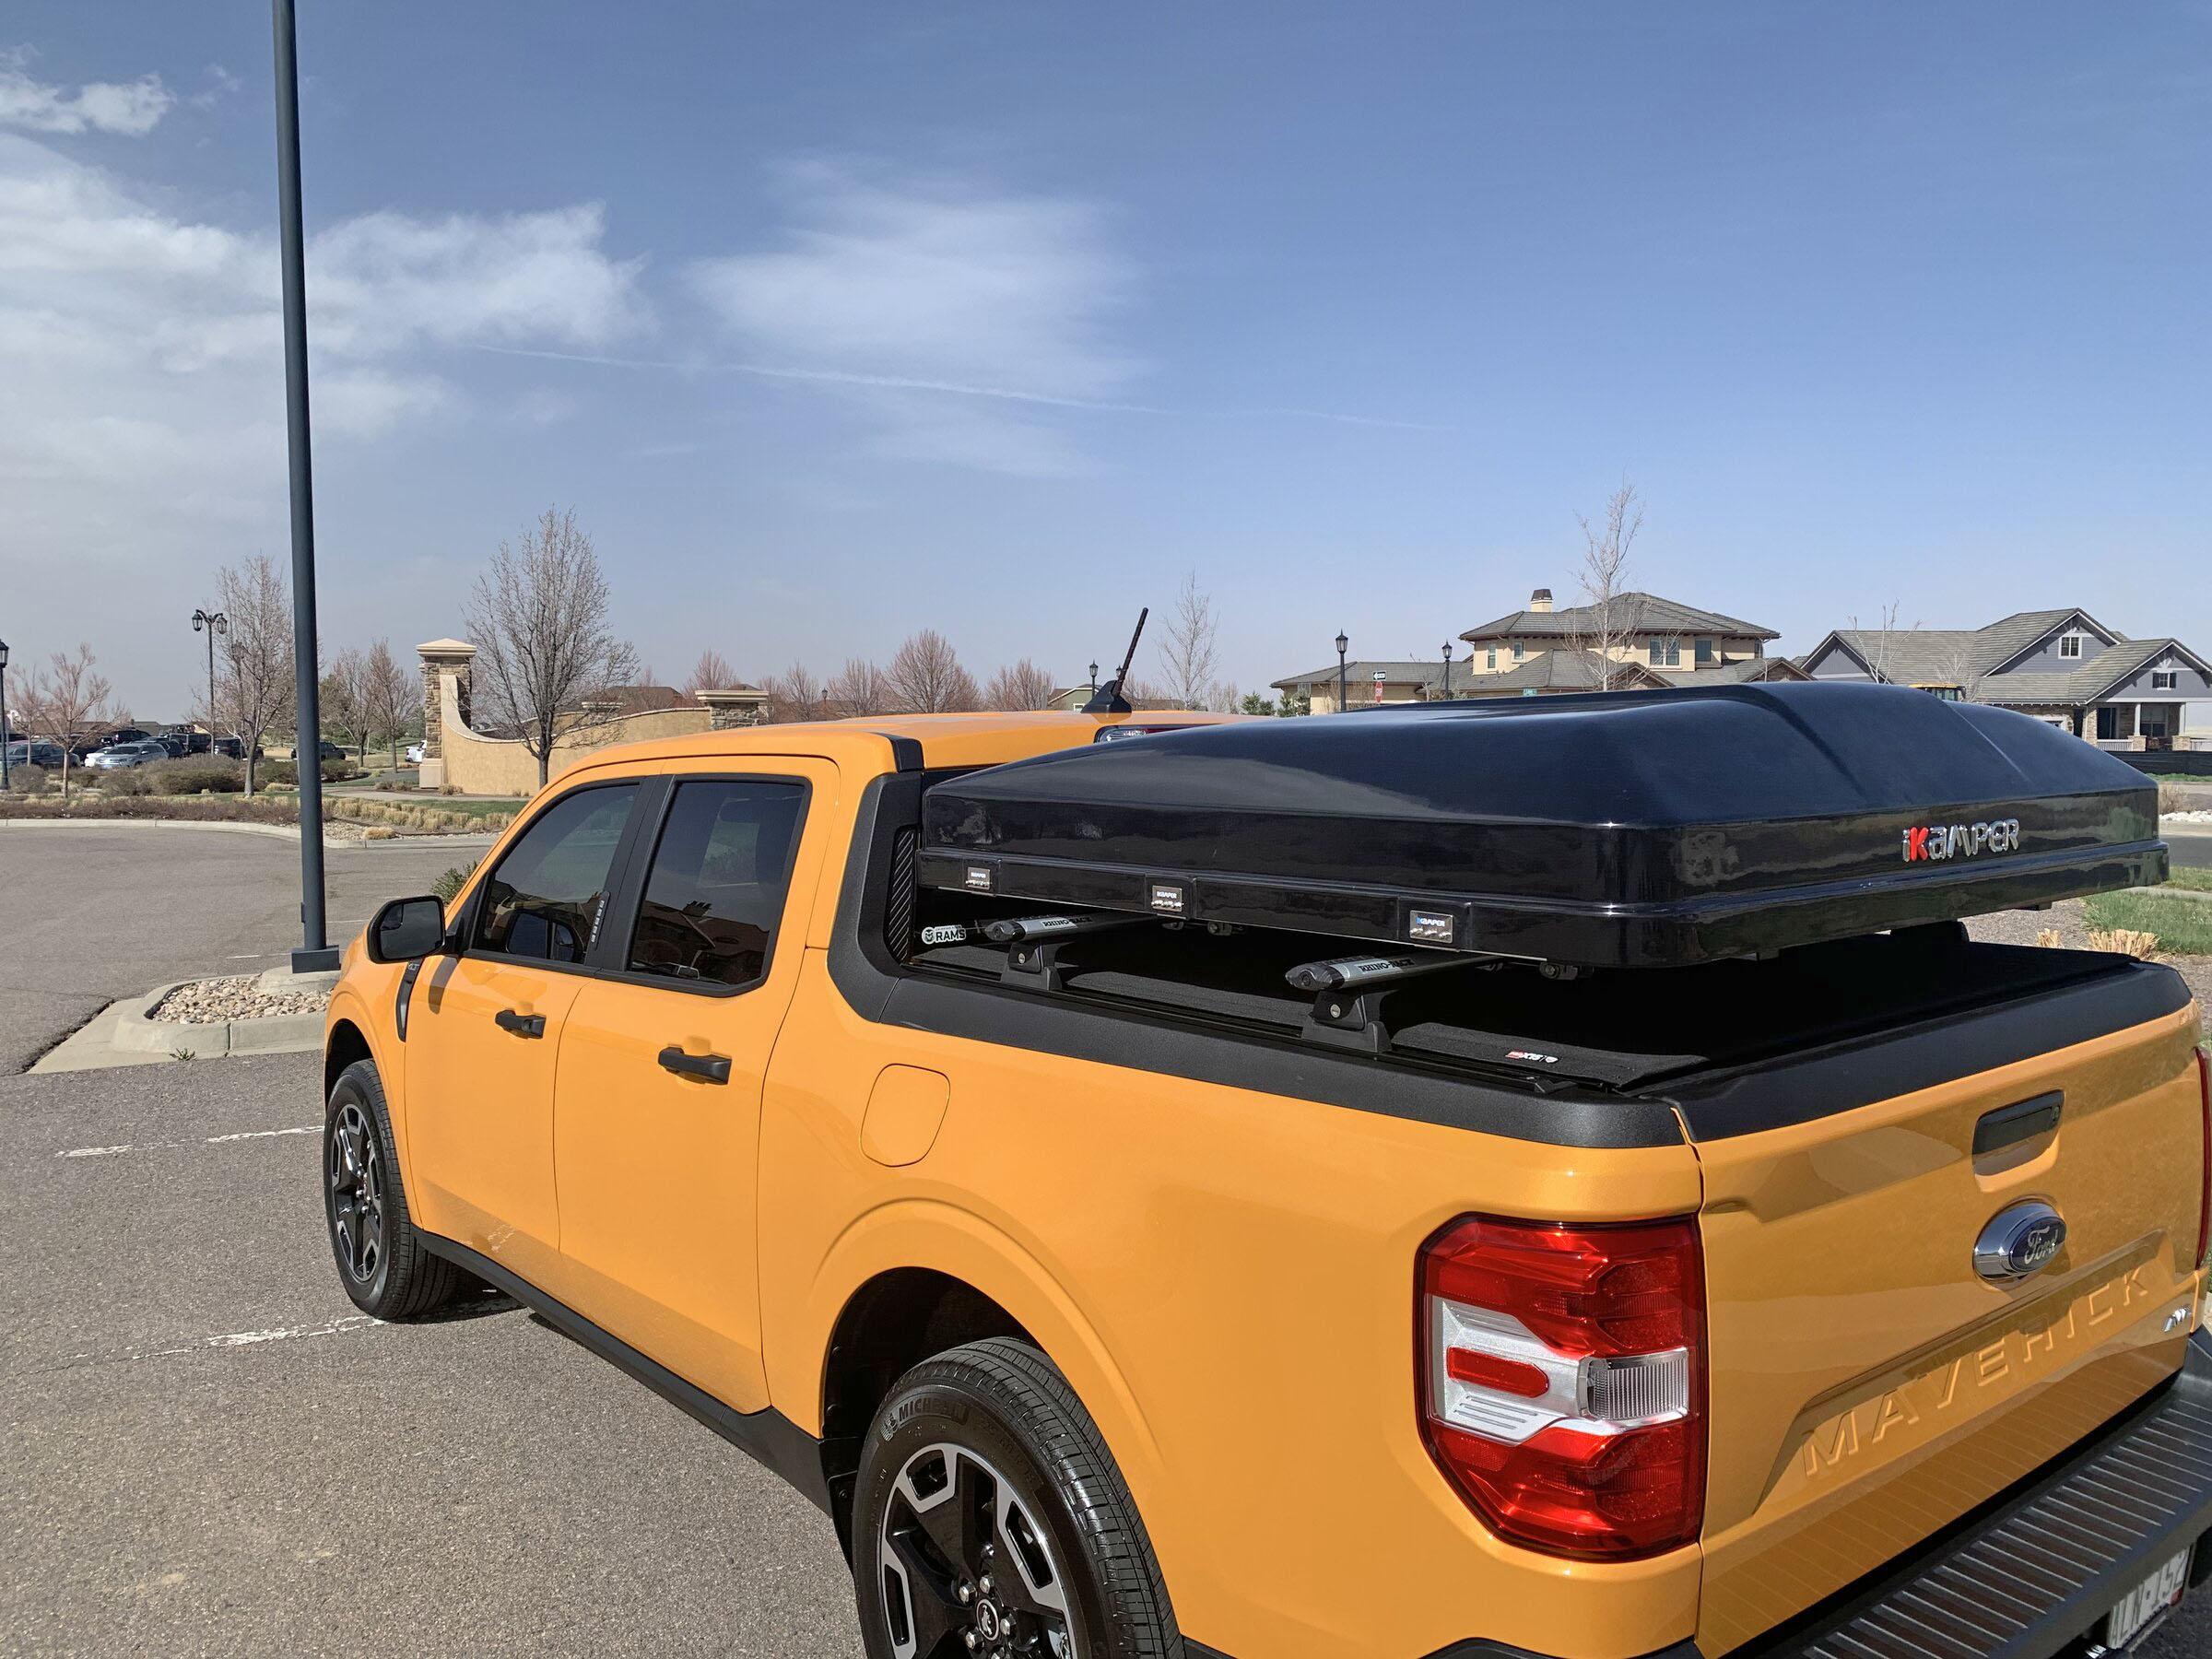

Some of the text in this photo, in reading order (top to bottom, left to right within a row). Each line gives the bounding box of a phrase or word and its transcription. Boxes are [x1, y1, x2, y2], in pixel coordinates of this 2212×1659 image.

[935, 929, 966, 941] RAMS
[2024, 1226, 2059, 1265] Ford
[1803, 1265, 2148, 1477] MAVERICK
